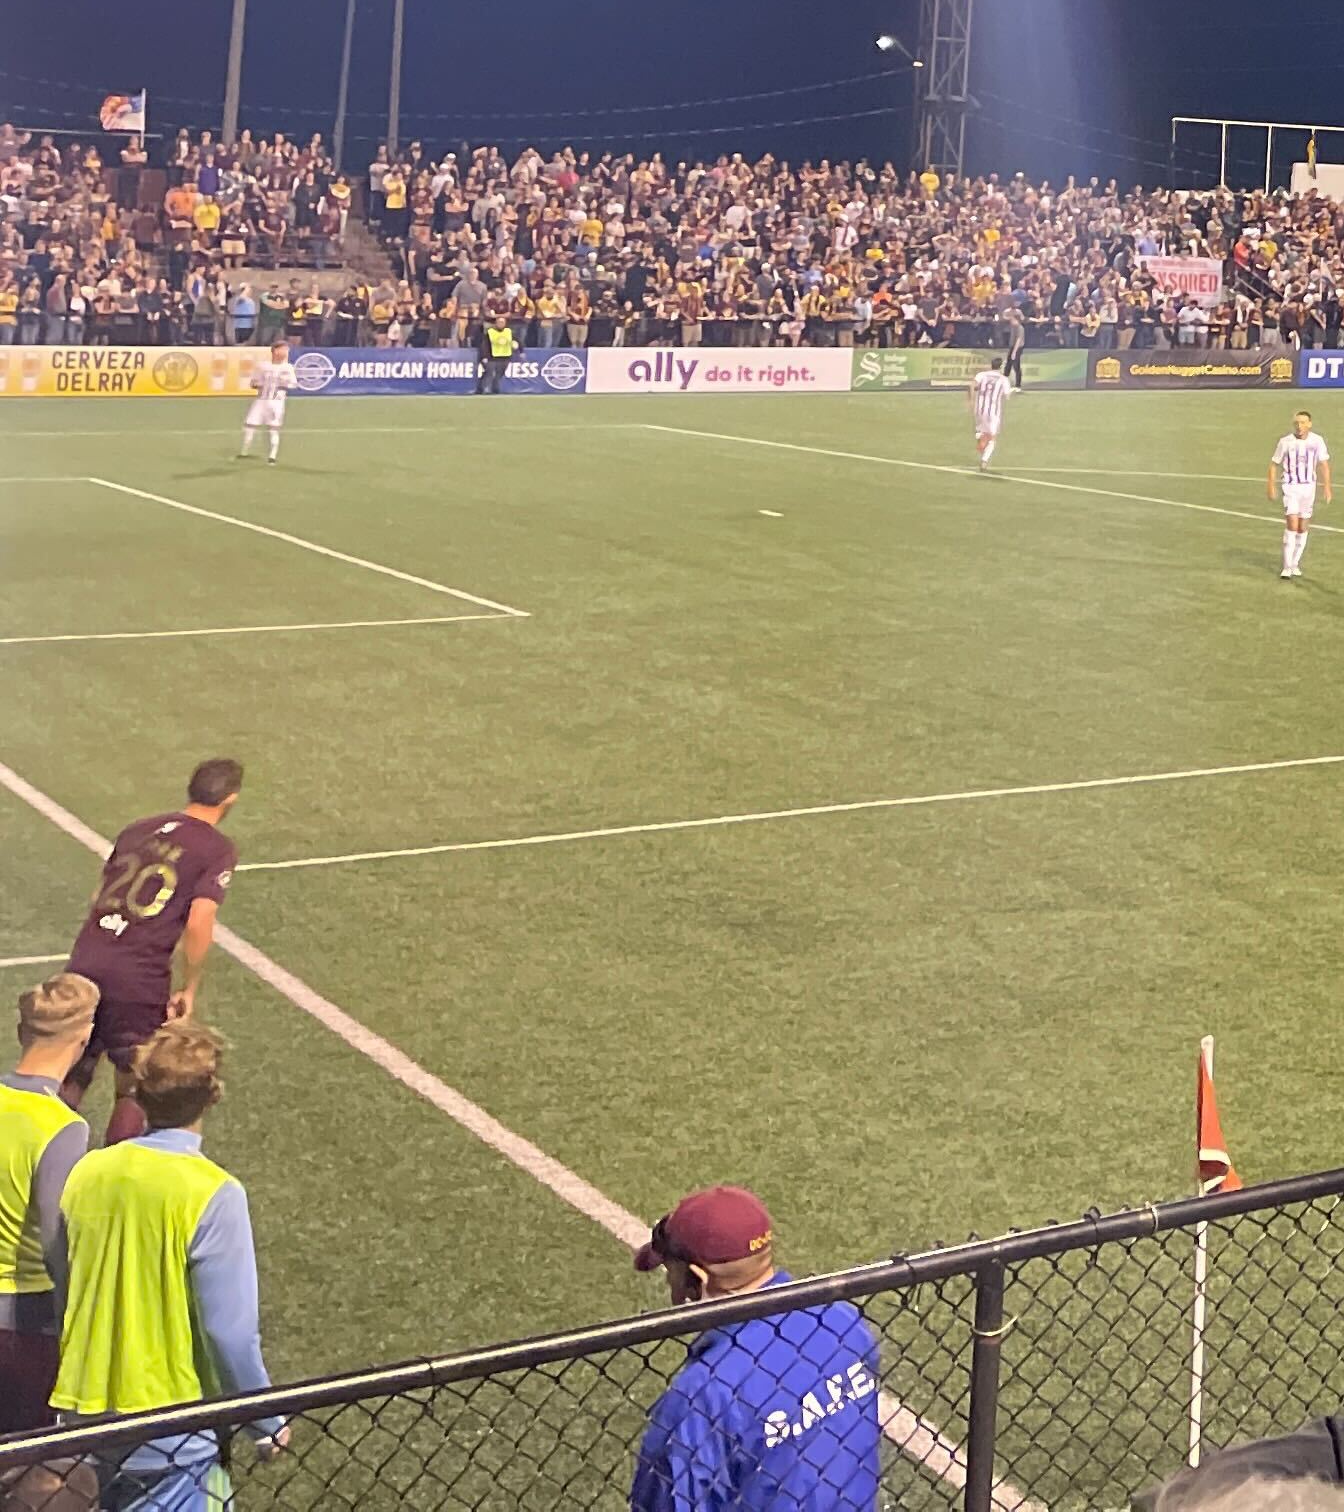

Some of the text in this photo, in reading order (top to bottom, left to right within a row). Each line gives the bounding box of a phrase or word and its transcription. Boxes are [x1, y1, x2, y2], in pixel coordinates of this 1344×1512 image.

[51, 350, 146, 370] CERVEZA
[337, 361, 423, 379] AMERICAN
[426, 362, 474, 379] HOME
[627, 351, 816, 390] ally do it right.
[56, 372, 137, 392] DELRAY
